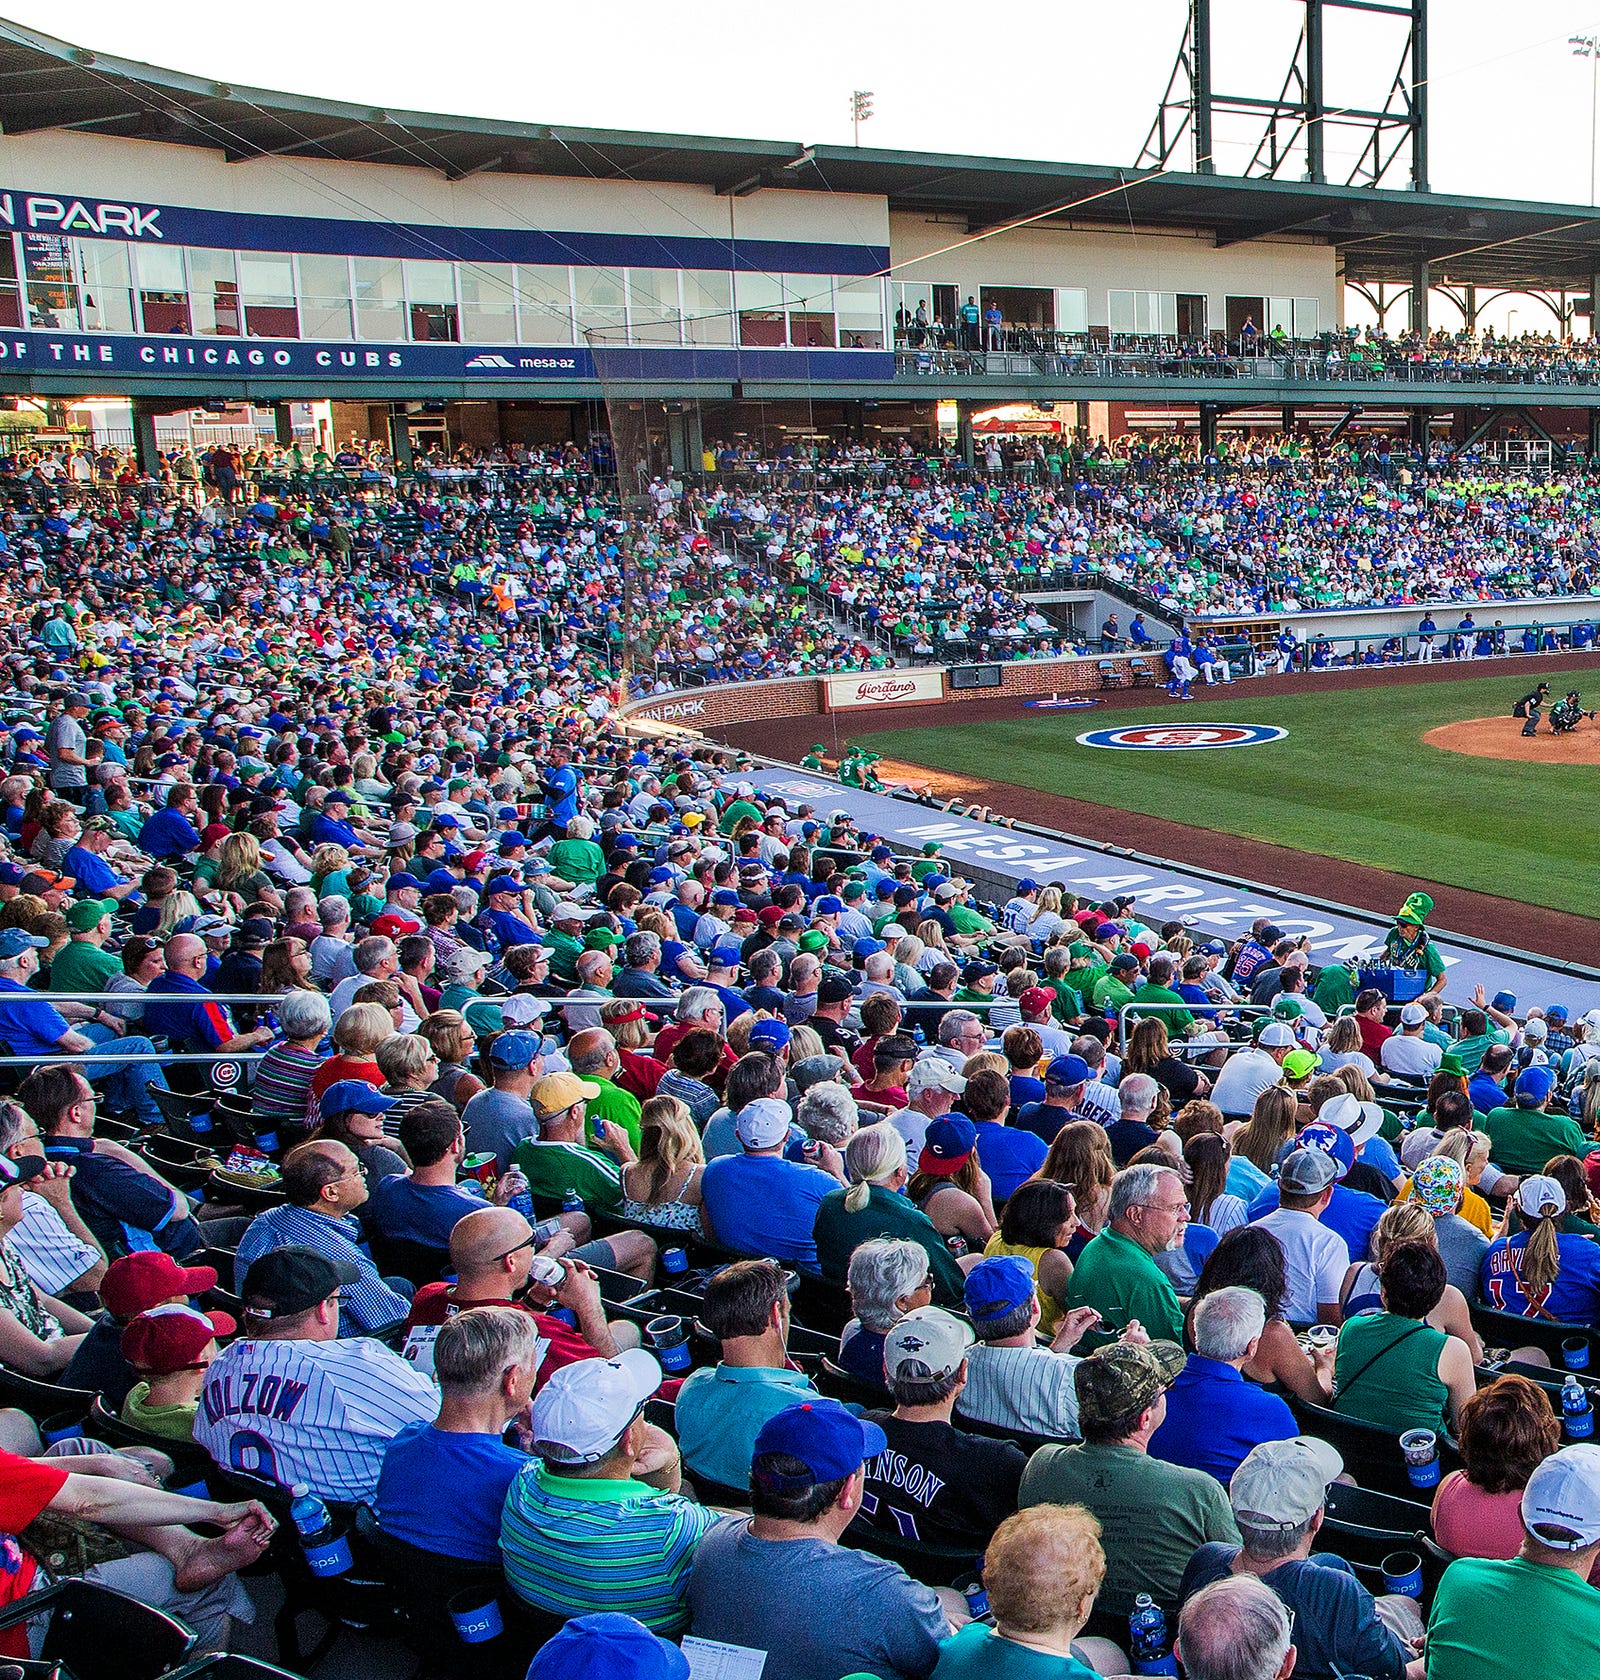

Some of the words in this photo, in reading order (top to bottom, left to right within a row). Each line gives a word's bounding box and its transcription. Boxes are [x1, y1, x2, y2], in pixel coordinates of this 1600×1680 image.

[26, 197, 164, 239] PARK
[49, 343, 113, 362] THE
[139, 346, 291, 367] CHICAGO
[315, 351, 402, 368] CUBS
[856, 680, 917, 699] Giordano's
[663, 699, 706, 721] PARK
[892, 821, 1089, 874] MESA
[1489, 1279, 1552, 1318] 17
